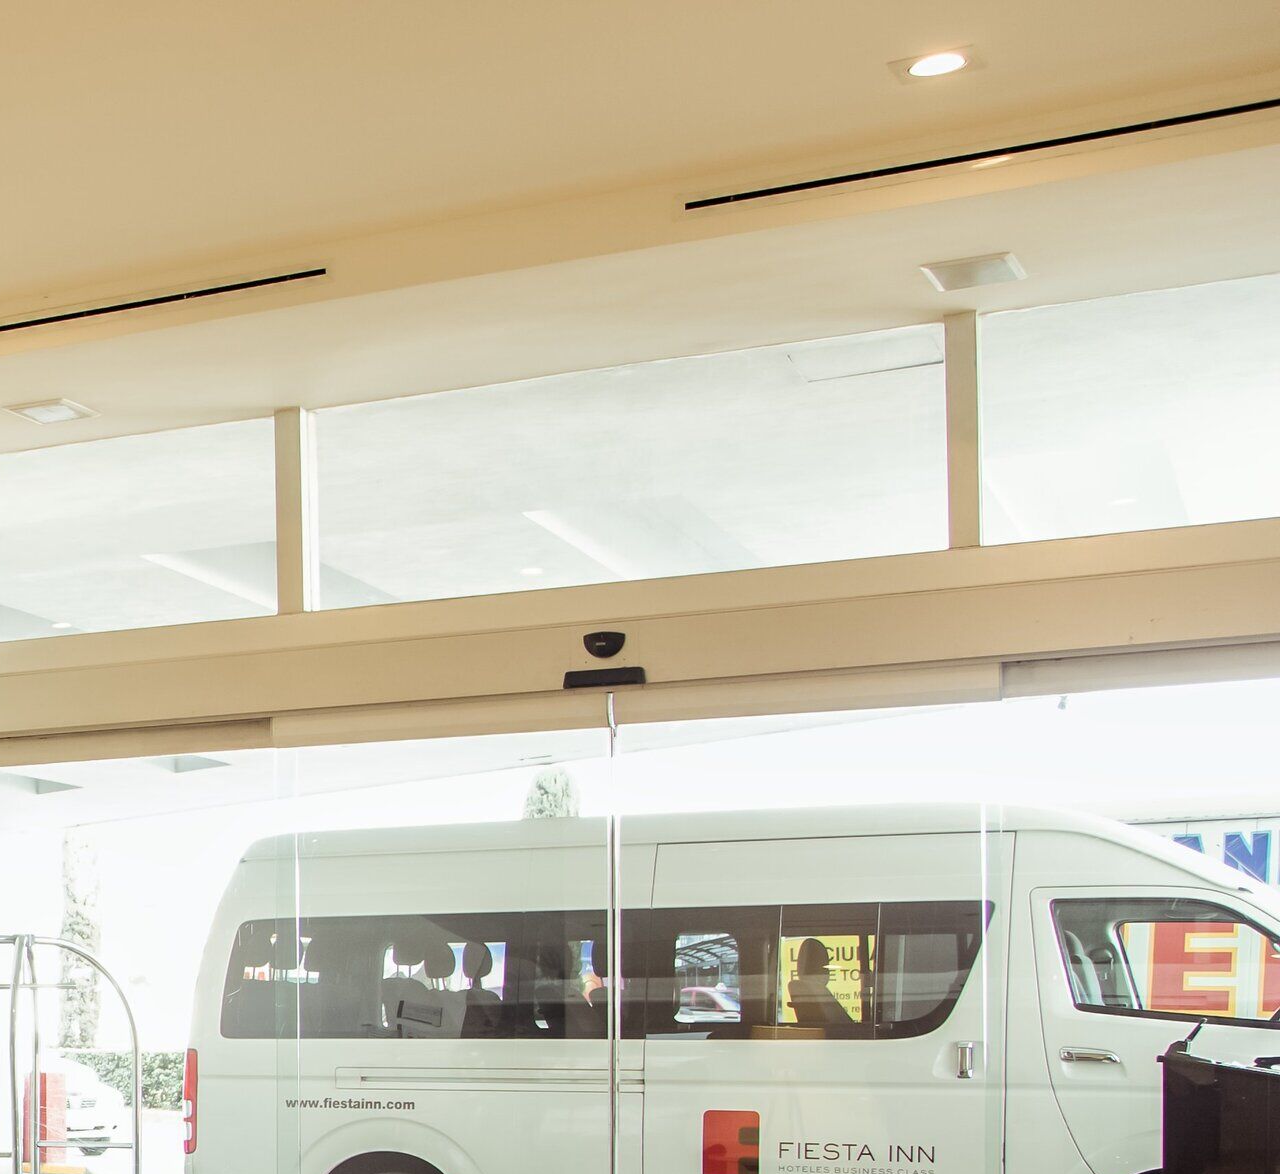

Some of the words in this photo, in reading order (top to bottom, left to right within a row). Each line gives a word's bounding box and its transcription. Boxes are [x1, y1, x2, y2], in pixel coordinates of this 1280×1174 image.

[285, 1097, 416, 1110] www.fiestainn.com
[778, 1142, 876, 1161] FIESTA
[889, 1144, 935, 1163] INN
[778, 1165, 831, 1174] HOTELES
